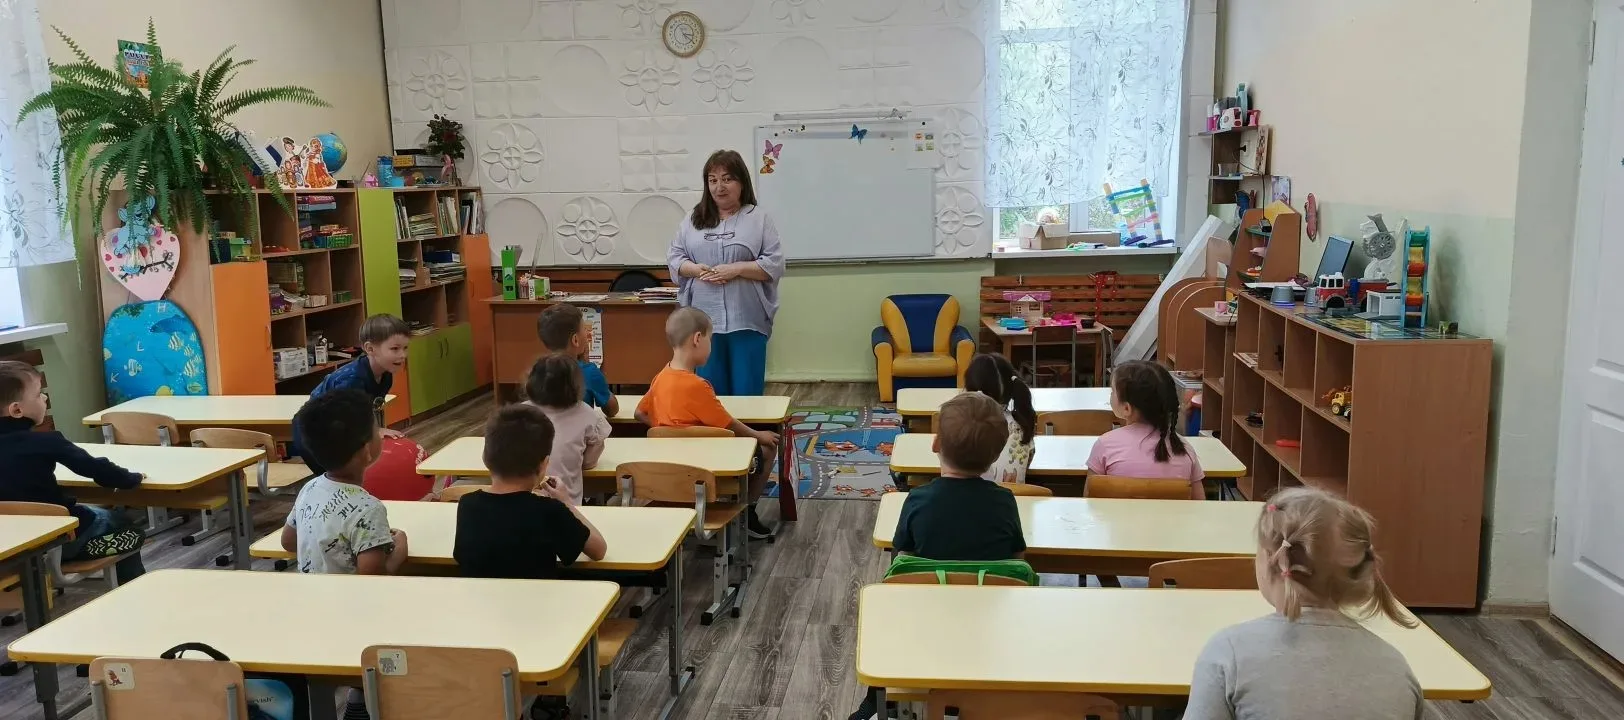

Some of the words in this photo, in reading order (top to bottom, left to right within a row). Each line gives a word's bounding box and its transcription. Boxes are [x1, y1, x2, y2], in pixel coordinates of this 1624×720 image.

[157, 303, 166, 313] H
[137, 341, 144, 351] L
[110, 372, 119, 383] K
